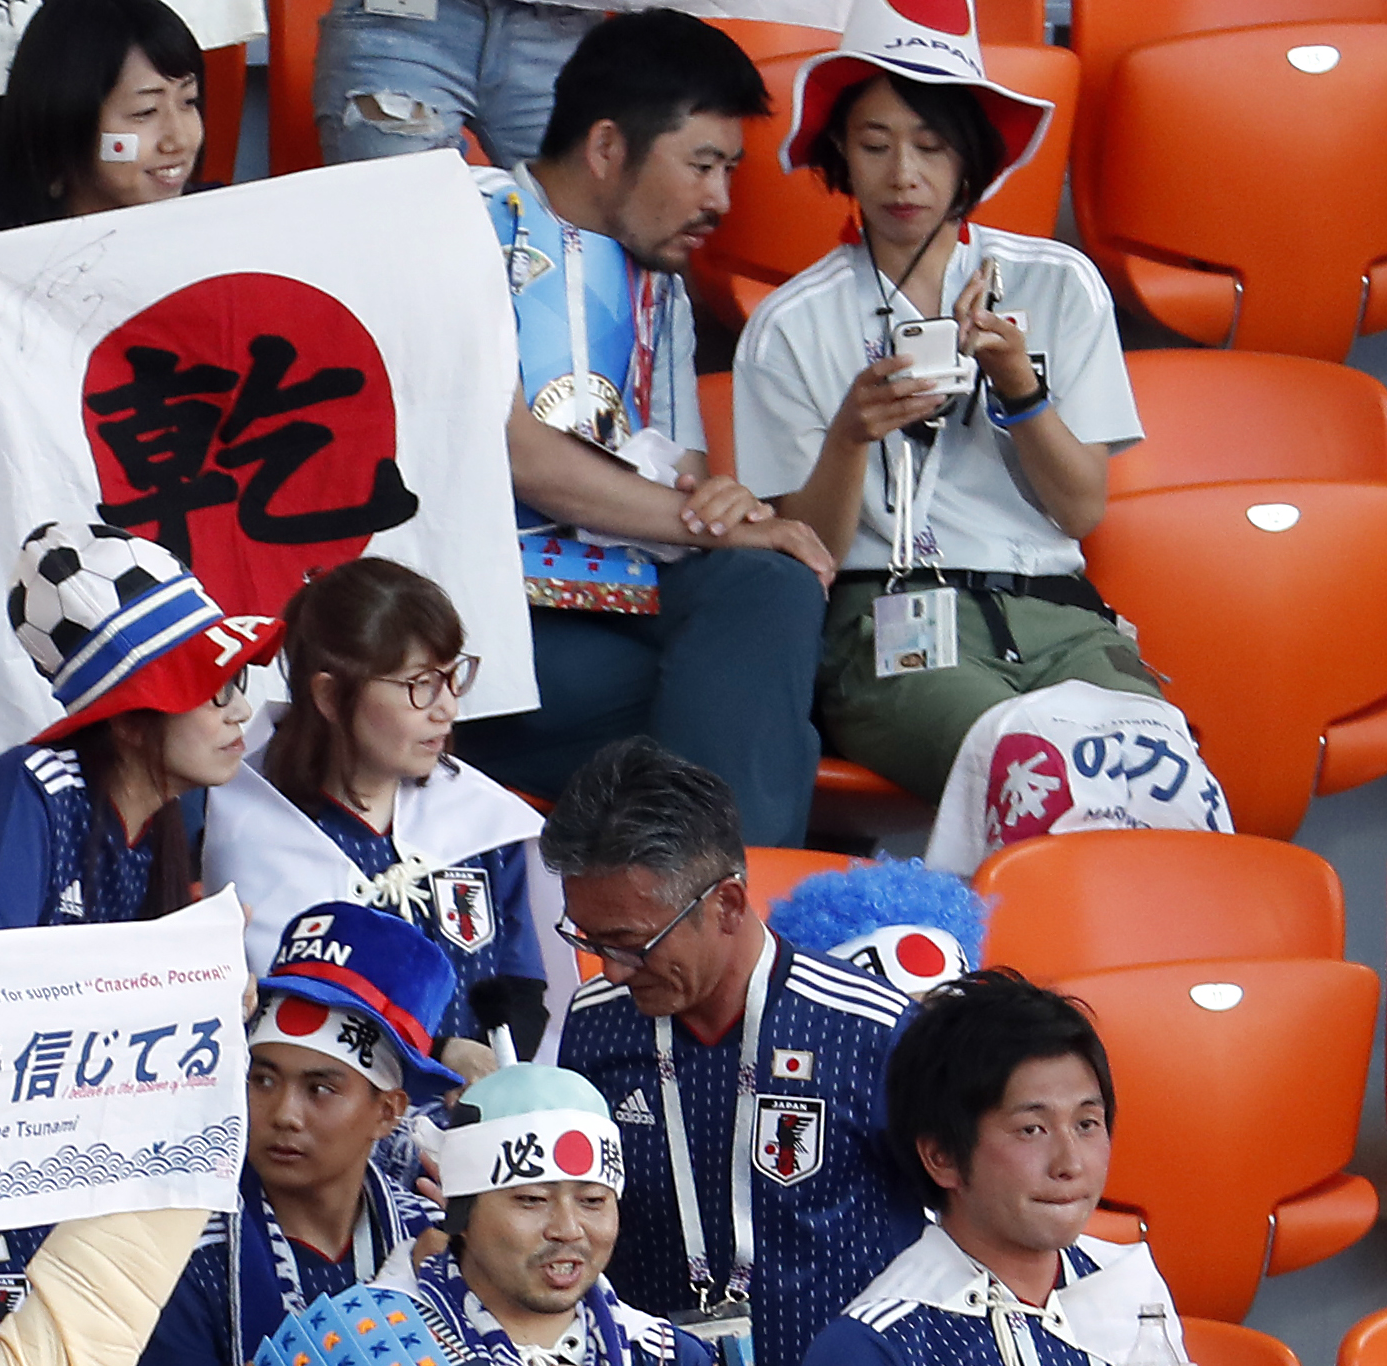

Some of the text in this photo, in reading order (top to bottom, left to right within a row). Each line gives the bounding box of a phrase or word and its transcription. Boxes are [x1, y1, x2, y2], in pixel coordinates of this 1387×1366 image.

[85, 334, 419, 570] 乾
[277, 938, 352, 967] APAN
[1, 988, 24, 1003] for
[25, 981, 84, 1002] support
[615, 1110, 656, 1125] adidas
[771, 1100, 808, 1111] JAPAN
[16, 1114, 80, 1138] Tsunami
[491, 1132, 545, 1184] 必
